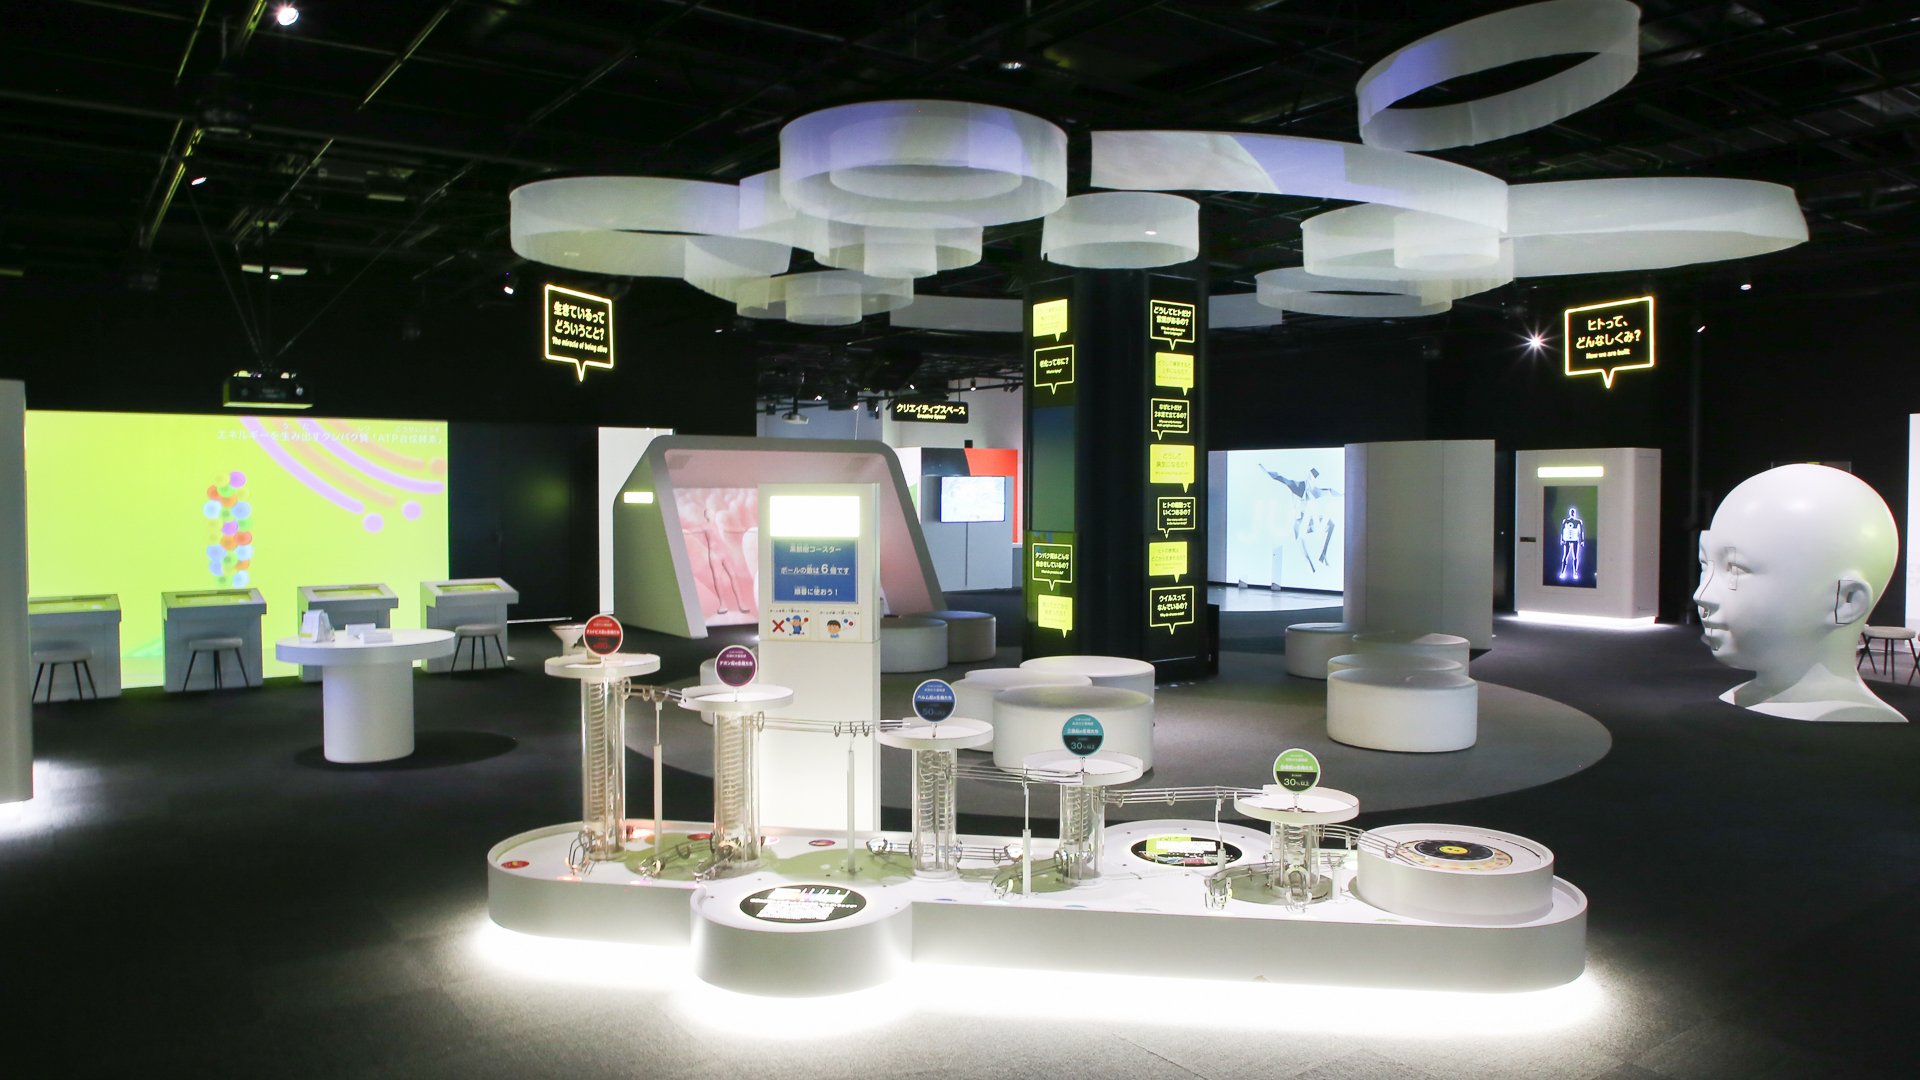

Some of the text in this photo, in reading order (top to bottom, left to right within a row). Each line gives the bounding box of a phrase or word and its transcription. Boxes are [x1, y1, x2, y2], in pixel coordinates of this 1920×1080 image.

[554, 301, 605, 324] 生きているって
[555, 319, 605, 341] どういうこと？
[1588, 315, 1628, 331] ヒトって、
[1576, 329, 1641, 349] どんなしくみ？
[897, 403, 966, 415] クリエイティブスペース
